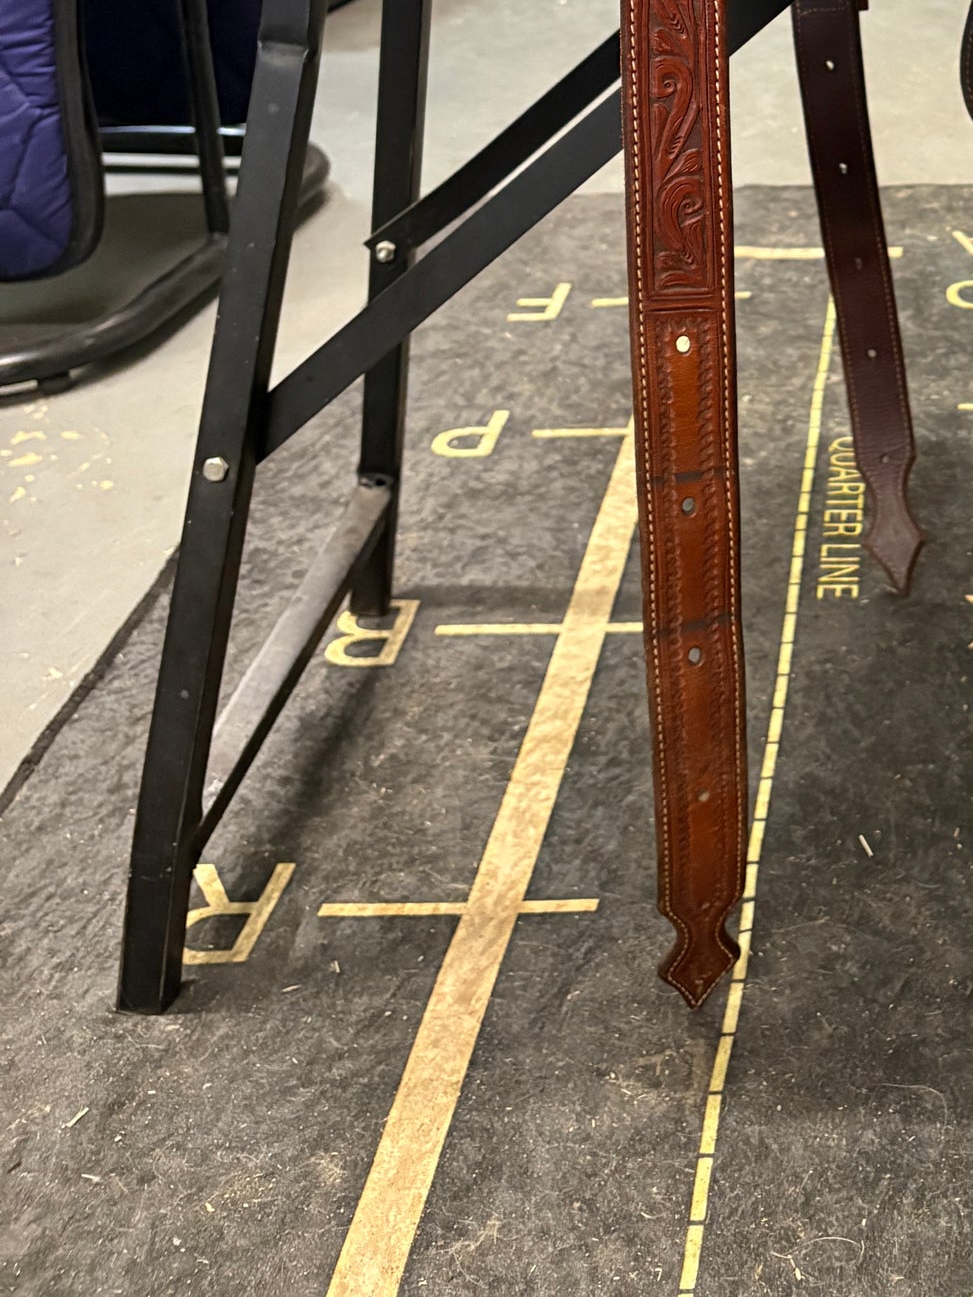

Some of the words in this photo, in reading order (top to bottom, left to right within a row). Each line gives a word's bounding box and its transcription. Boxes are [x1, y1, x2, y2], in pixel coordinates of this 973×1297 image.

[506, 282, 572, 322] F
[430, 409, 510, 458] P
[823, 436, 866, 536] QUARTER
[816, 544, 861, 600] LINE
